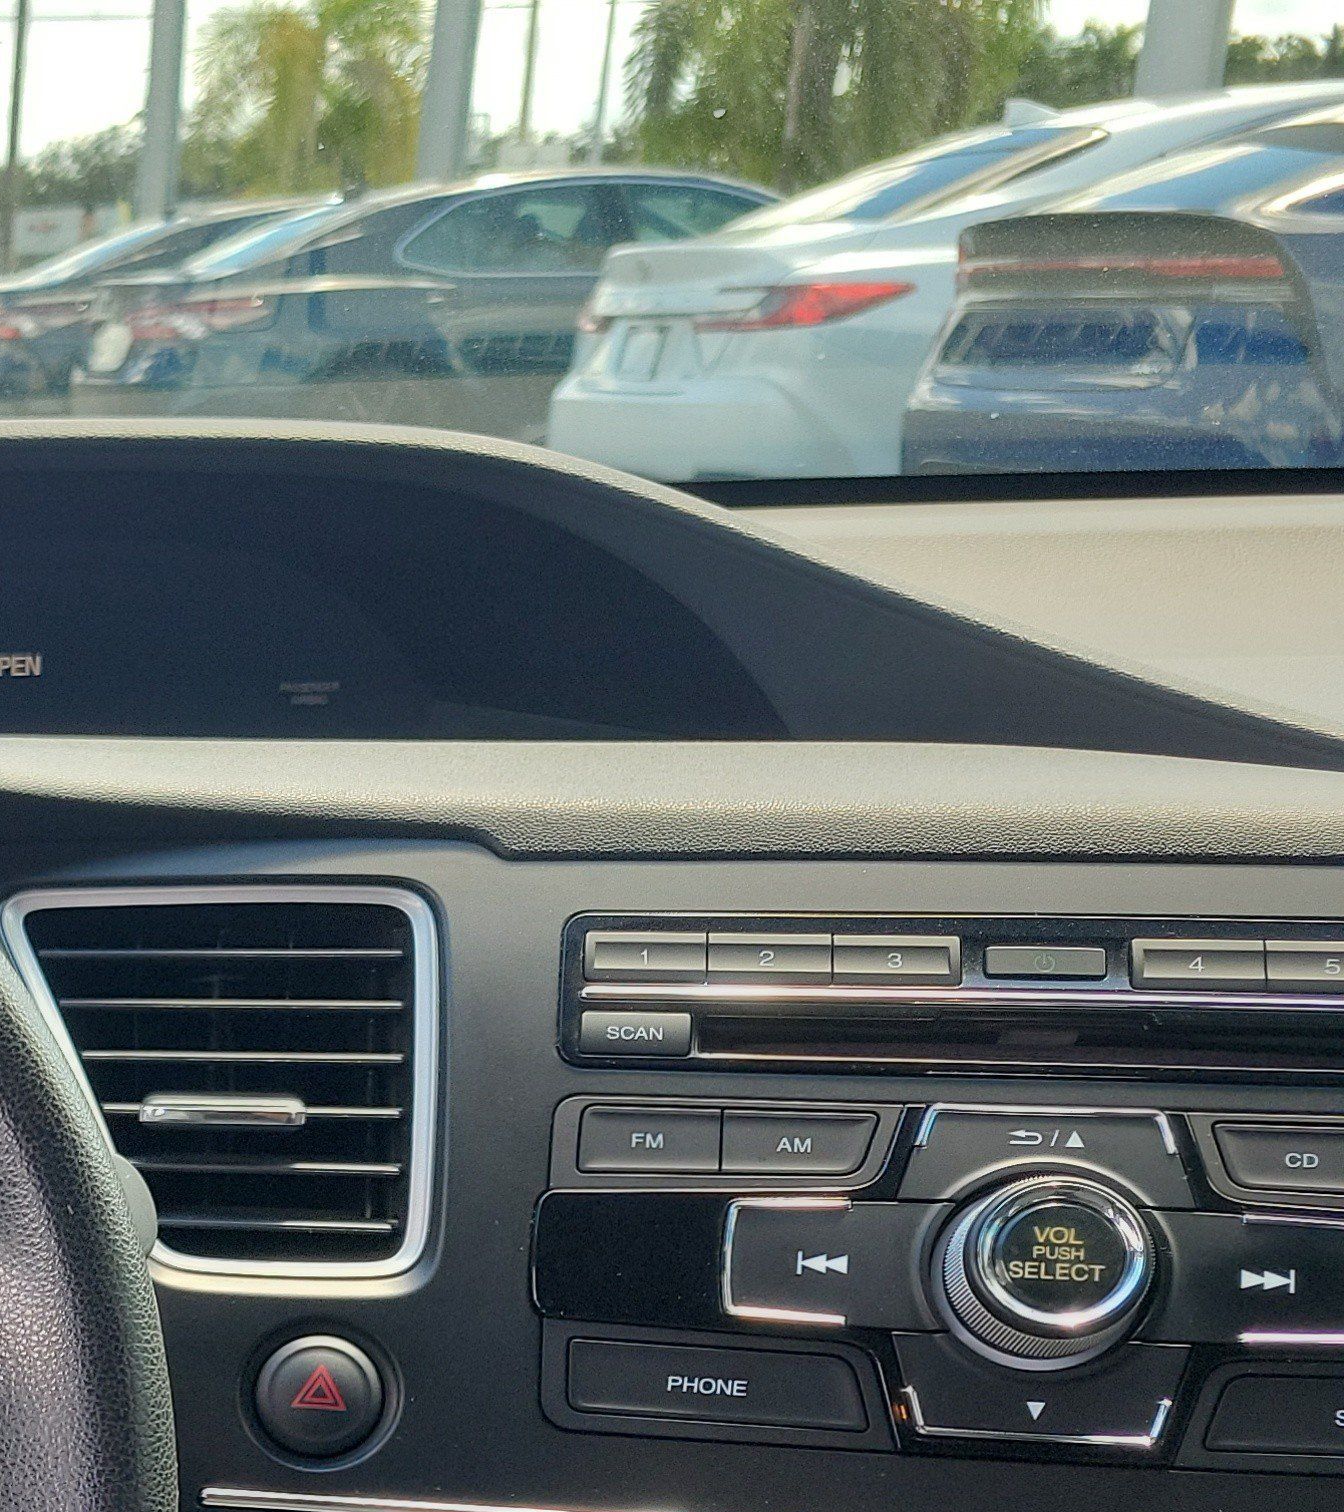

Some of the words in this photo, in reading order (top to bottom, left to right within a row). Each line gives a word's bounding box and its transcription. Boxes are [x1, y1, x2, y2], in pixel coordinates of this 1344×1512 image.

[640, 949, 651, 966] 1
[758, 950, 776, 968] 2
[886, 952, 904, 970] 3
[1188, 956, 1206, 974] 4
[1323, 958, 1341, 975] 5
[606, 1024, 665, 1042] SCAN
[631, 1132, 664, 1150] FM
[775, 1137, 813, 1154] AM
[1284, 1152, 1320, 1169] CD
[1033, 1226, 1085, 1246] VOL
[1032, 1246, 1086, 1262] PUSH
[1008, 1261, 1106, 1283] SELECT
[666, 1375, 748, 1398] PHONE
